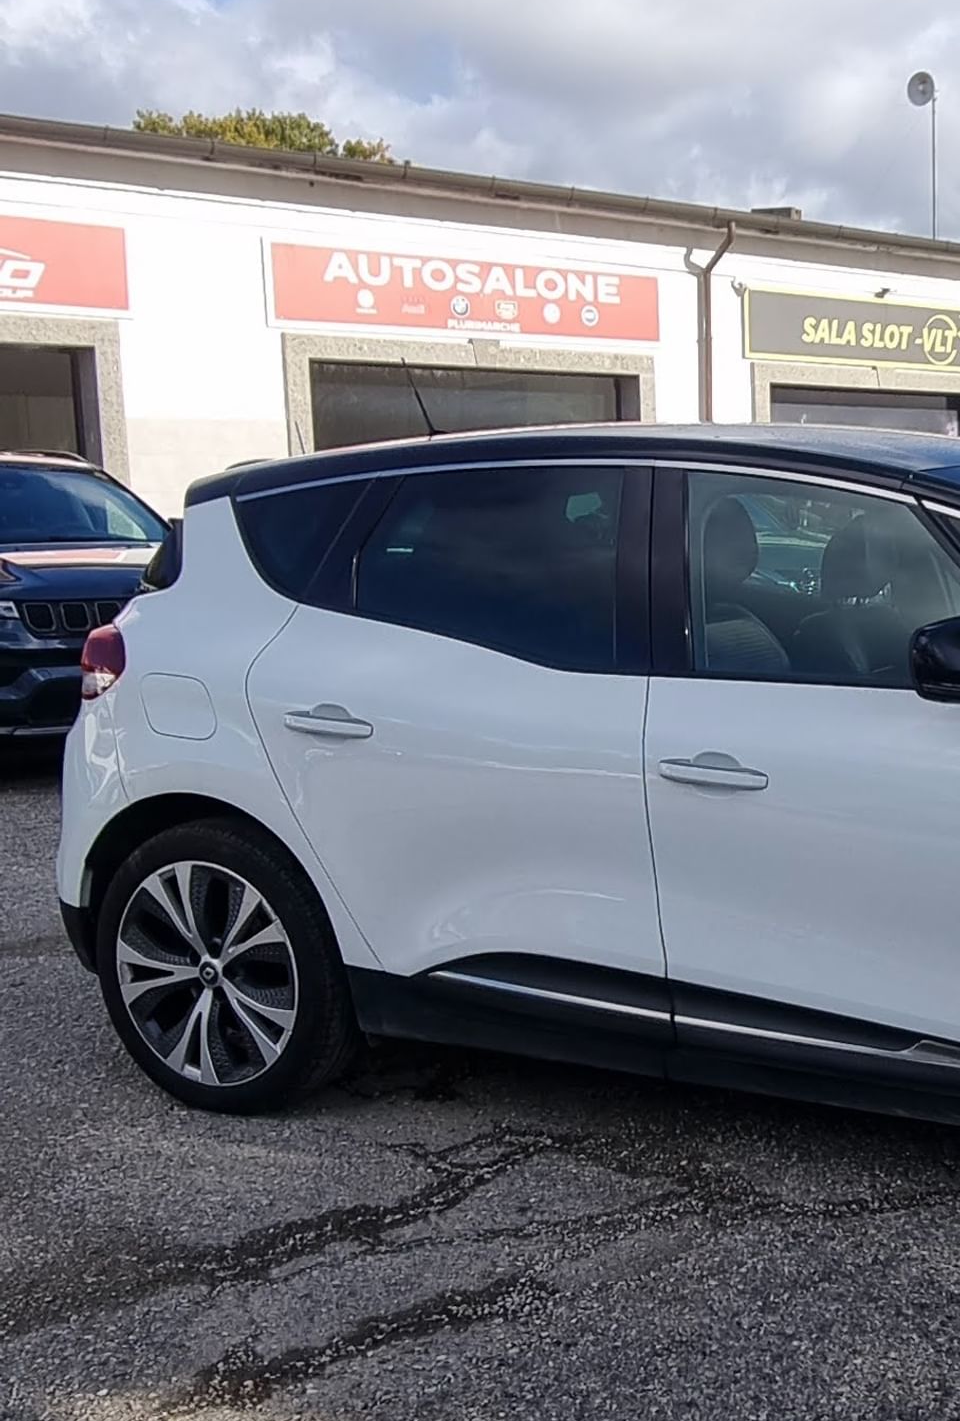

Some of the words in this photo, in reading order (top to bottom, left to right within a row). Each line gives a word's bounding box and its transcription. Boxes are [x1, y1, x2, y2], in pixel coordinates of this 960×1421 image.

[323, 251, 621, 304] AUTOSALONE
[802, 317, 857, 346] SALA
[860, 322, 913, 350] SLOT
